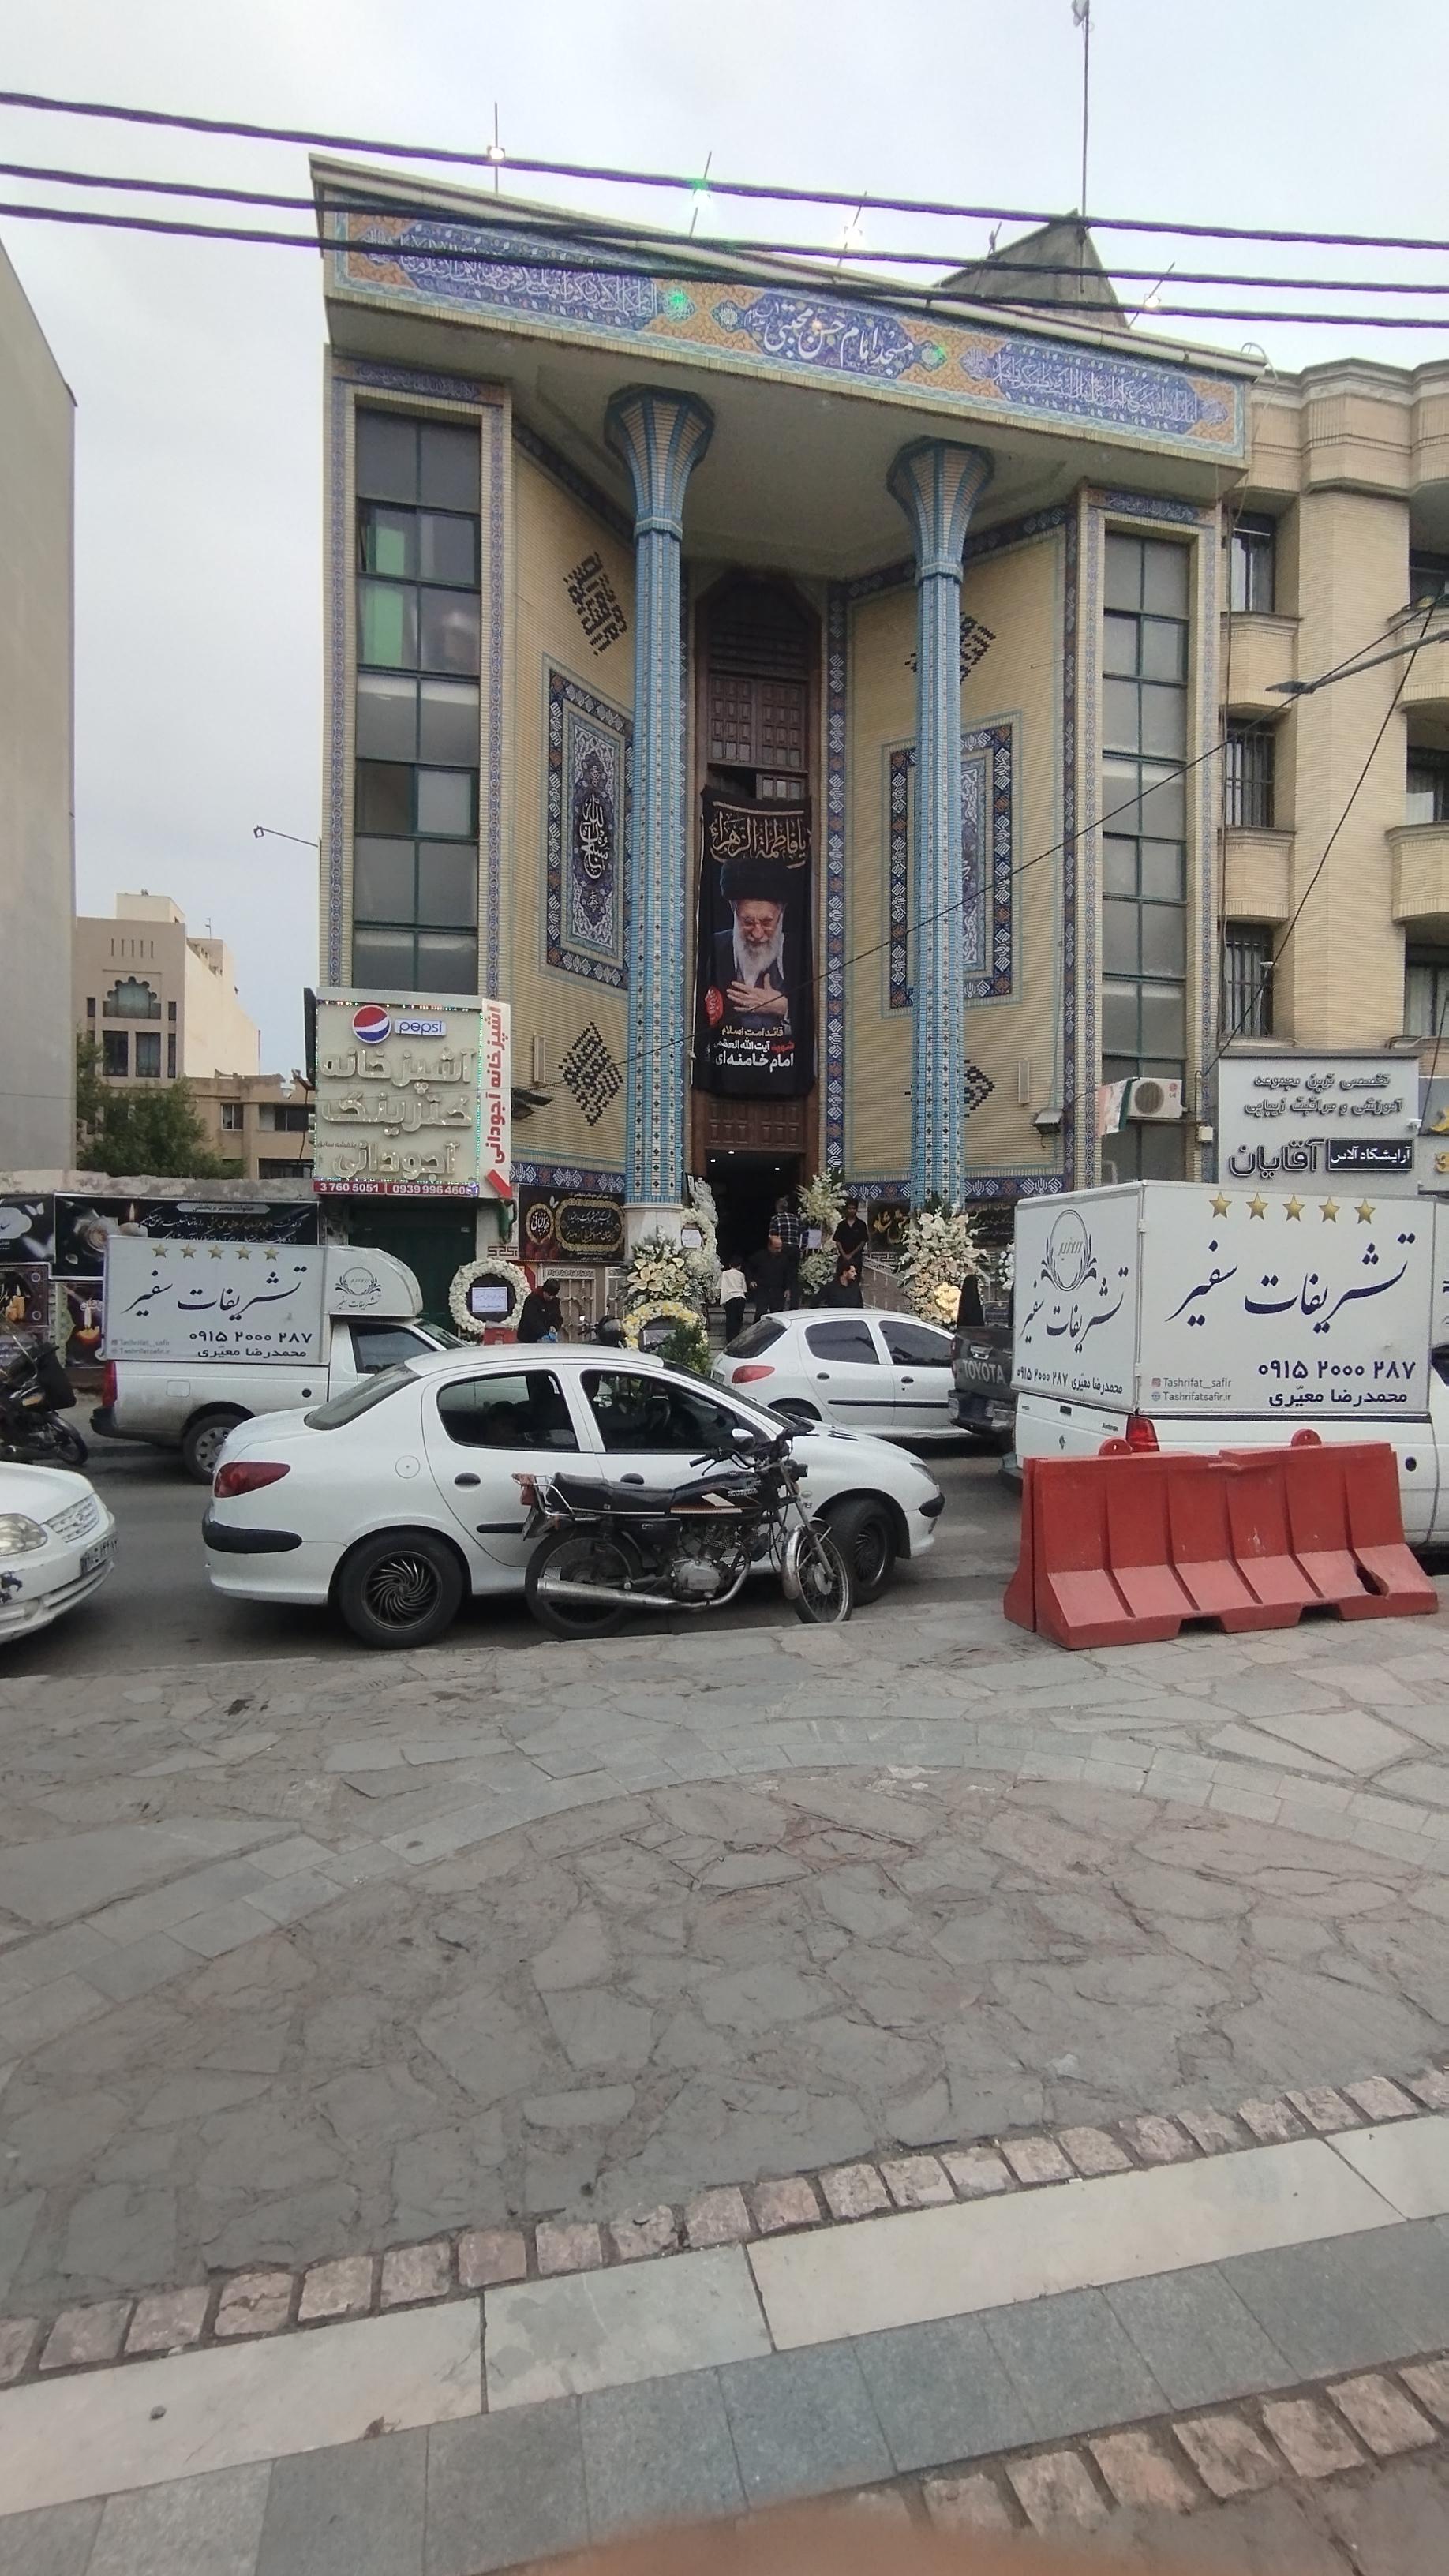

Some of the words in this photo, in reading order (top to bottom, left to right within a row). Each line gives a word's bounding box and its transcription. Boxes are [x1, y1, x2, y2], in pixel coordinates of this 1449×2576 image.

[763, 303, 814, 358] مجتبی
[798, 318, 845, 359] حسن
[841, 326, 879, 368] امام
[871, 330, 914, 376] مسجد
[399, 1020, 442, 1035] pepsi
[769, 1053, 794, 1073] امام
[1254, 1075, 1301, 1091] مجموعه
[1306, 1073, 1335, 1093] ترین
[1340, 1073, 1391, 1090] تخصصی
[322, 1092, 472, 1136] کترینگ
[1244, 1097, 1287, 1117] زیبایی
[1290, 1096, 1336, 1117] مراقبت
[1339, 1103, 1348, 1114] و
[1351, 1097, 1404, 1115] آموزشی
[485, 1092, 506, 1164] آجودانی
[332, 1142, 459, 1181] آجودانی
[1229, 1136, 1326, 1178] آقایان
[1360, 1145, 1412, 1164] آرایشگاه
[329, 1183, 350, 1192] 760
[353, 1184, 379, 1193] 5051
[393, 1185, 421, 1194] 0939
[422, 1185, 443, 1194] 996
[120, 1269, 173, 1316] سفیر
[178, 1265, 308, 1321] تشریفات
[1164, 1239, 1240, 1327] سفیر
[1244, 1232, 1417, 1335] تشریفات
[1017, 1279, 1044, 1343] سفیر
[1046, 1267, 1129, 1353] تشریفات
[189, 1331, 228, 1342] ۰۹۱۵
[234, 1331, 271, 1342] ۲۰۰۰
[279, 1332, 313, 1343] ۲۸۷
[962, 1359, 1006, 1384] TOYOTA
[1259, 1360, 1309, 1380] ۰۹۱۵
[1318, 1361, 1365, 1380] ۲۰۰۰
[1373, 1361, 1416, 1380] ۲۸۷
[1163, 1391, 1231, 1401] Tashrifatsafir.ir
[1331, 1388, 1408, 1407] محمدرضا
